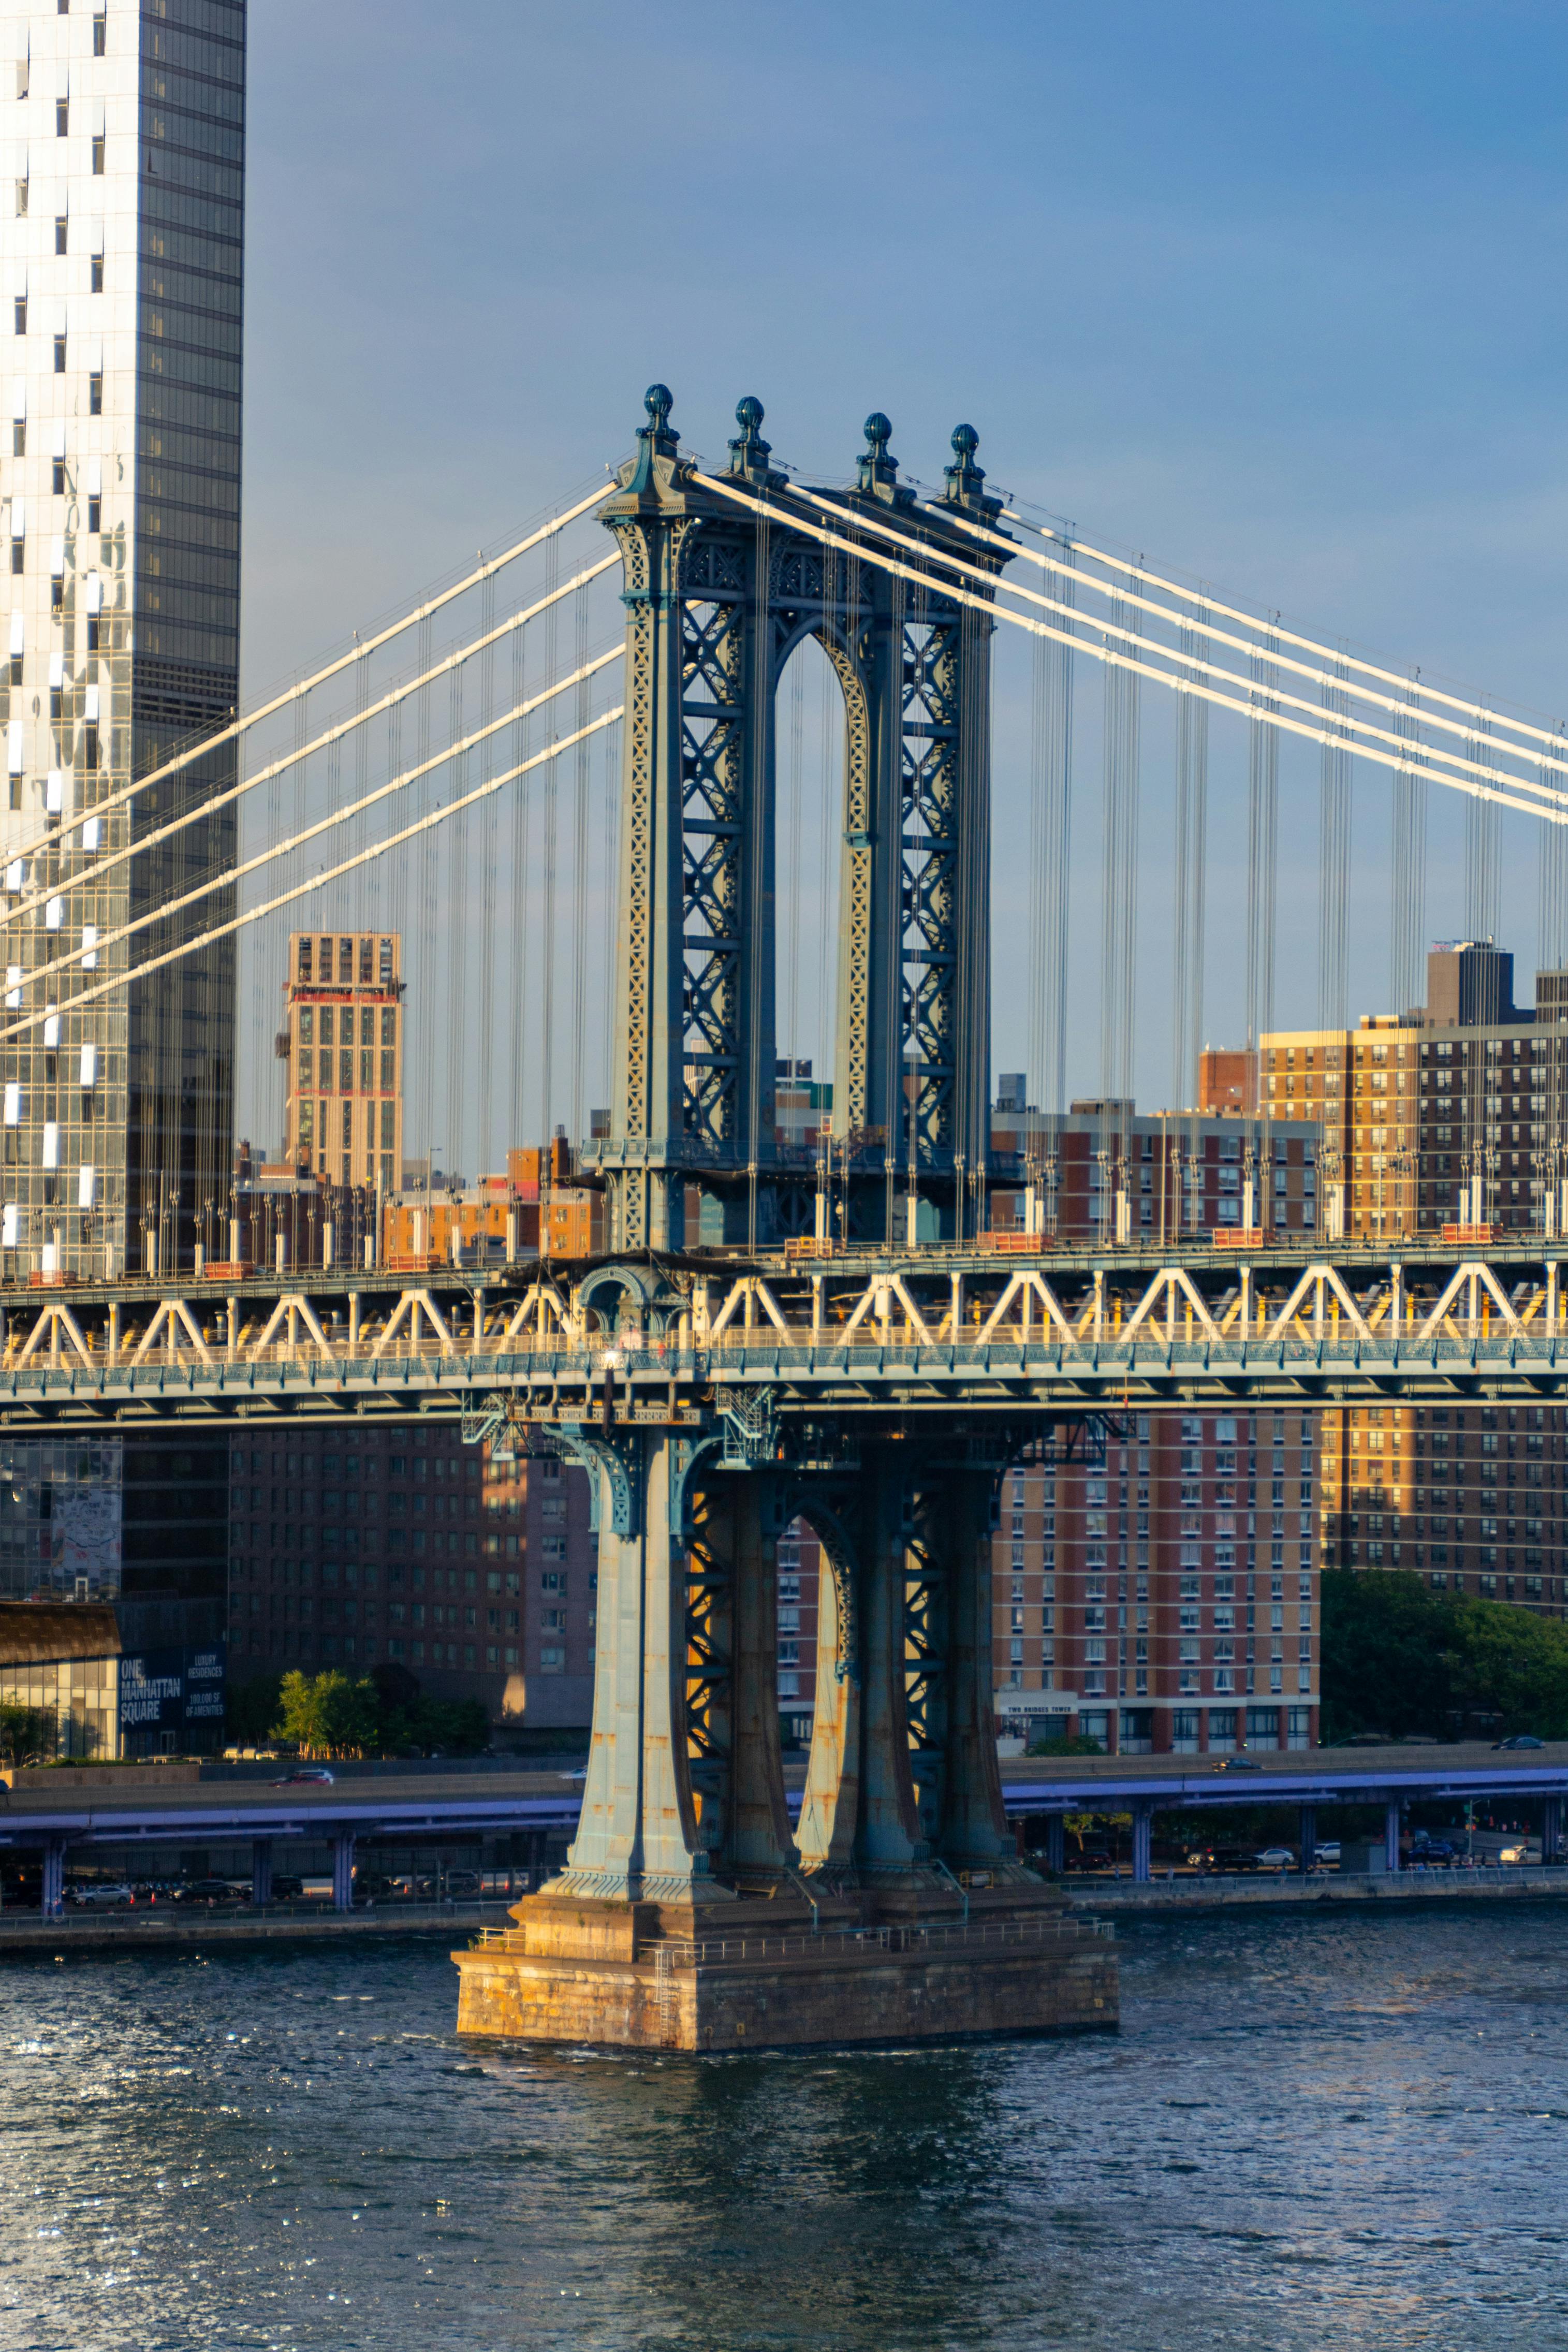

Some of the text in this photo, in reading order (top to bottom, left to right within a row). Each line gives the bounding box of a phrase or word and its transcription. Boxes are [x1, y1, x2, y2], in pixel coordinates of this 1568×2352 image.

[195, 1654, 216, 1666] LUXURY
[121, 1659, 142, 1679] ONE
[188, 1666, 223, 1678] RESIDENCES
[121, 1678, 180, 1701] MANHATTAN
[213, 1692, 221, 1703] SF
[121, 1700, 160, 1725] SQUARE
[186, 1704, 223, 1717] OF AMENITIES
